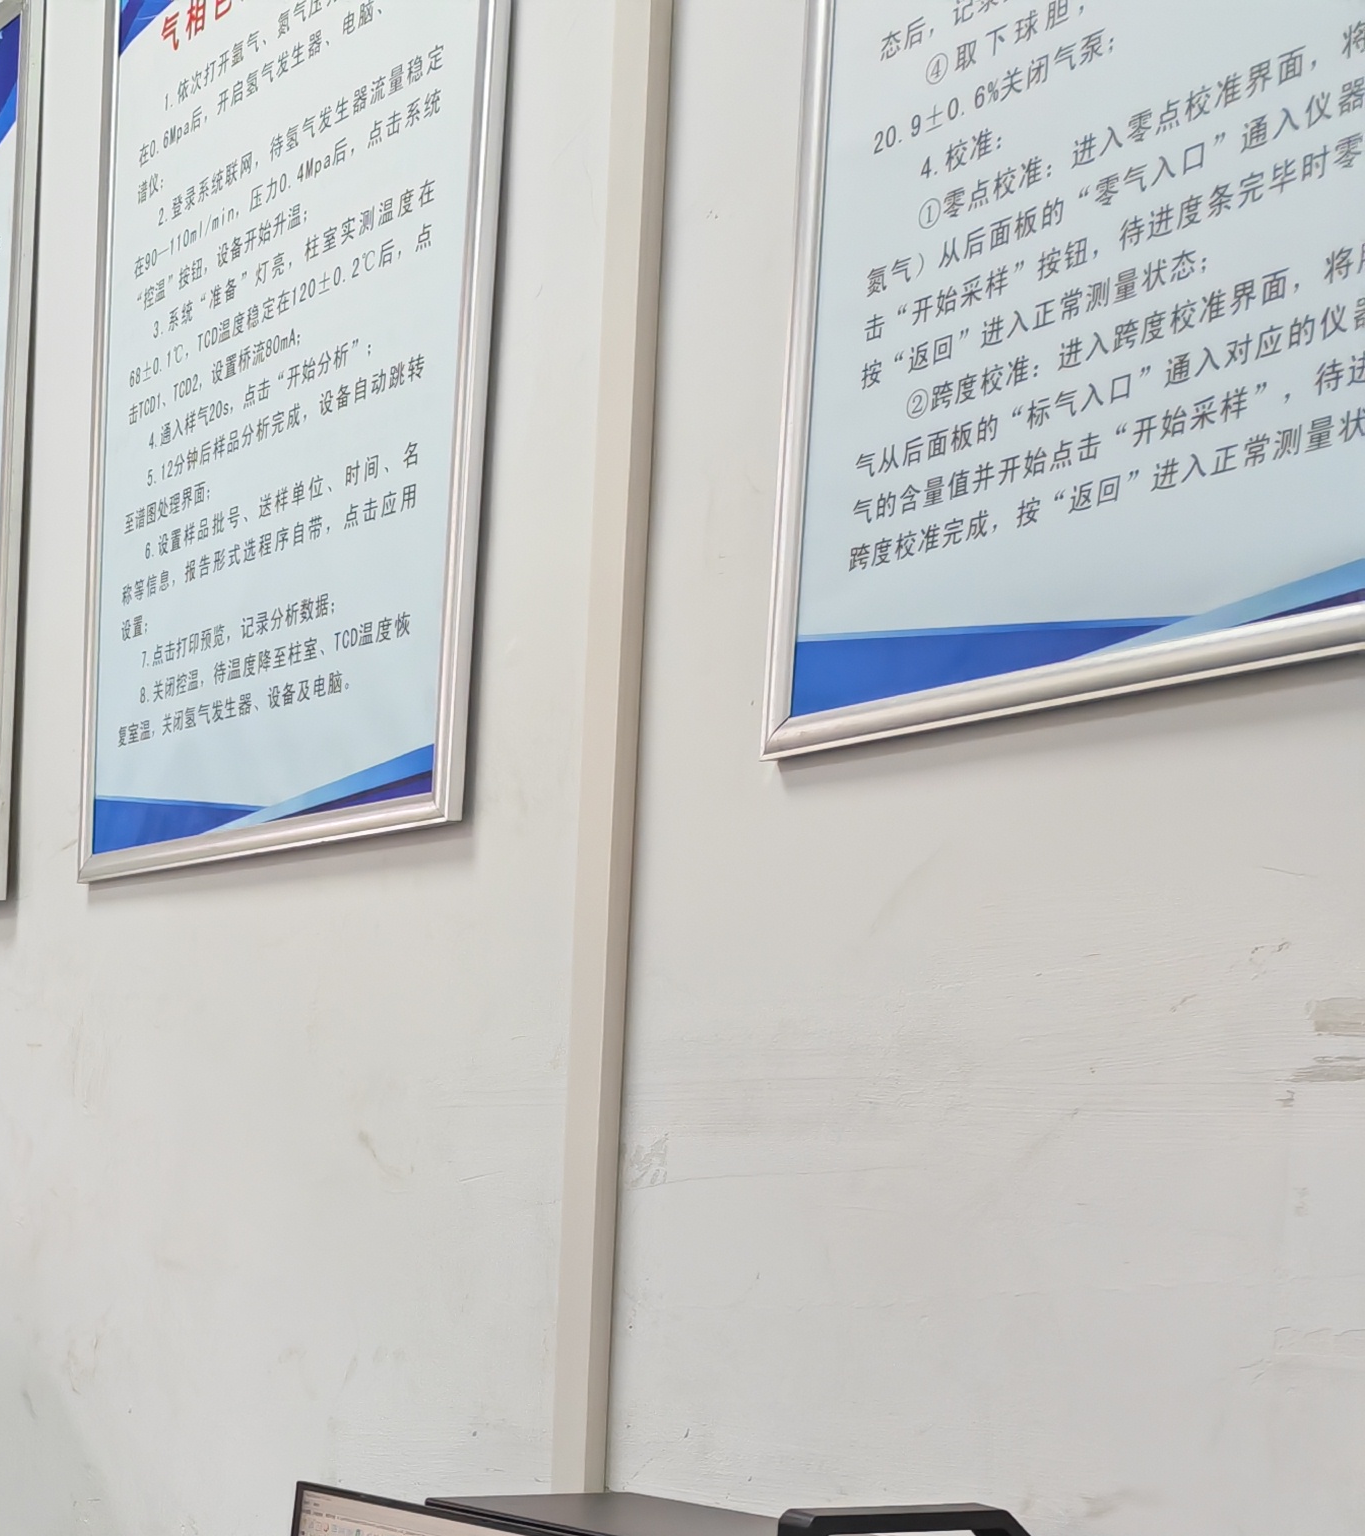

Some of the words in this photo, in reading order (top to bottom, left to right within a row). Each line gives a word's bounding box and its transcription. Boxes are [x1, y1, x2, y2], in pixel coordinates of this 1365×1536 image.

[164, 0, 338, 111] 1.依次打开氩气、氮气压
[157, 44, 445, 227] 2.登录系统联网，待氢气发生器流量稳定
[920, 127, 1003, 180] 4.校准：
[860, 248, 1209, 391] 按“返回”进入正常测量状态；
[906, 240, 1365, 420] ②跨度校准：进入跨度校准界面，将
[121, 483, 418, 607] 称等信息，报告形式选程序自带，点击应用
[144, 440, 421, 561] 6.设置样品批号、送样单位、时间、名
[120, 614, 149, 642] 设置；
[138, 611, 412, 705] 8.关闭控温，待温度降至柱室、TCD温度恢
[140, 592, 337, 669] 7.点击打印预览，记录分析数据；
[117, 670, 352, 749] 复室温，关闭氢气发生器、设备及电脑。
